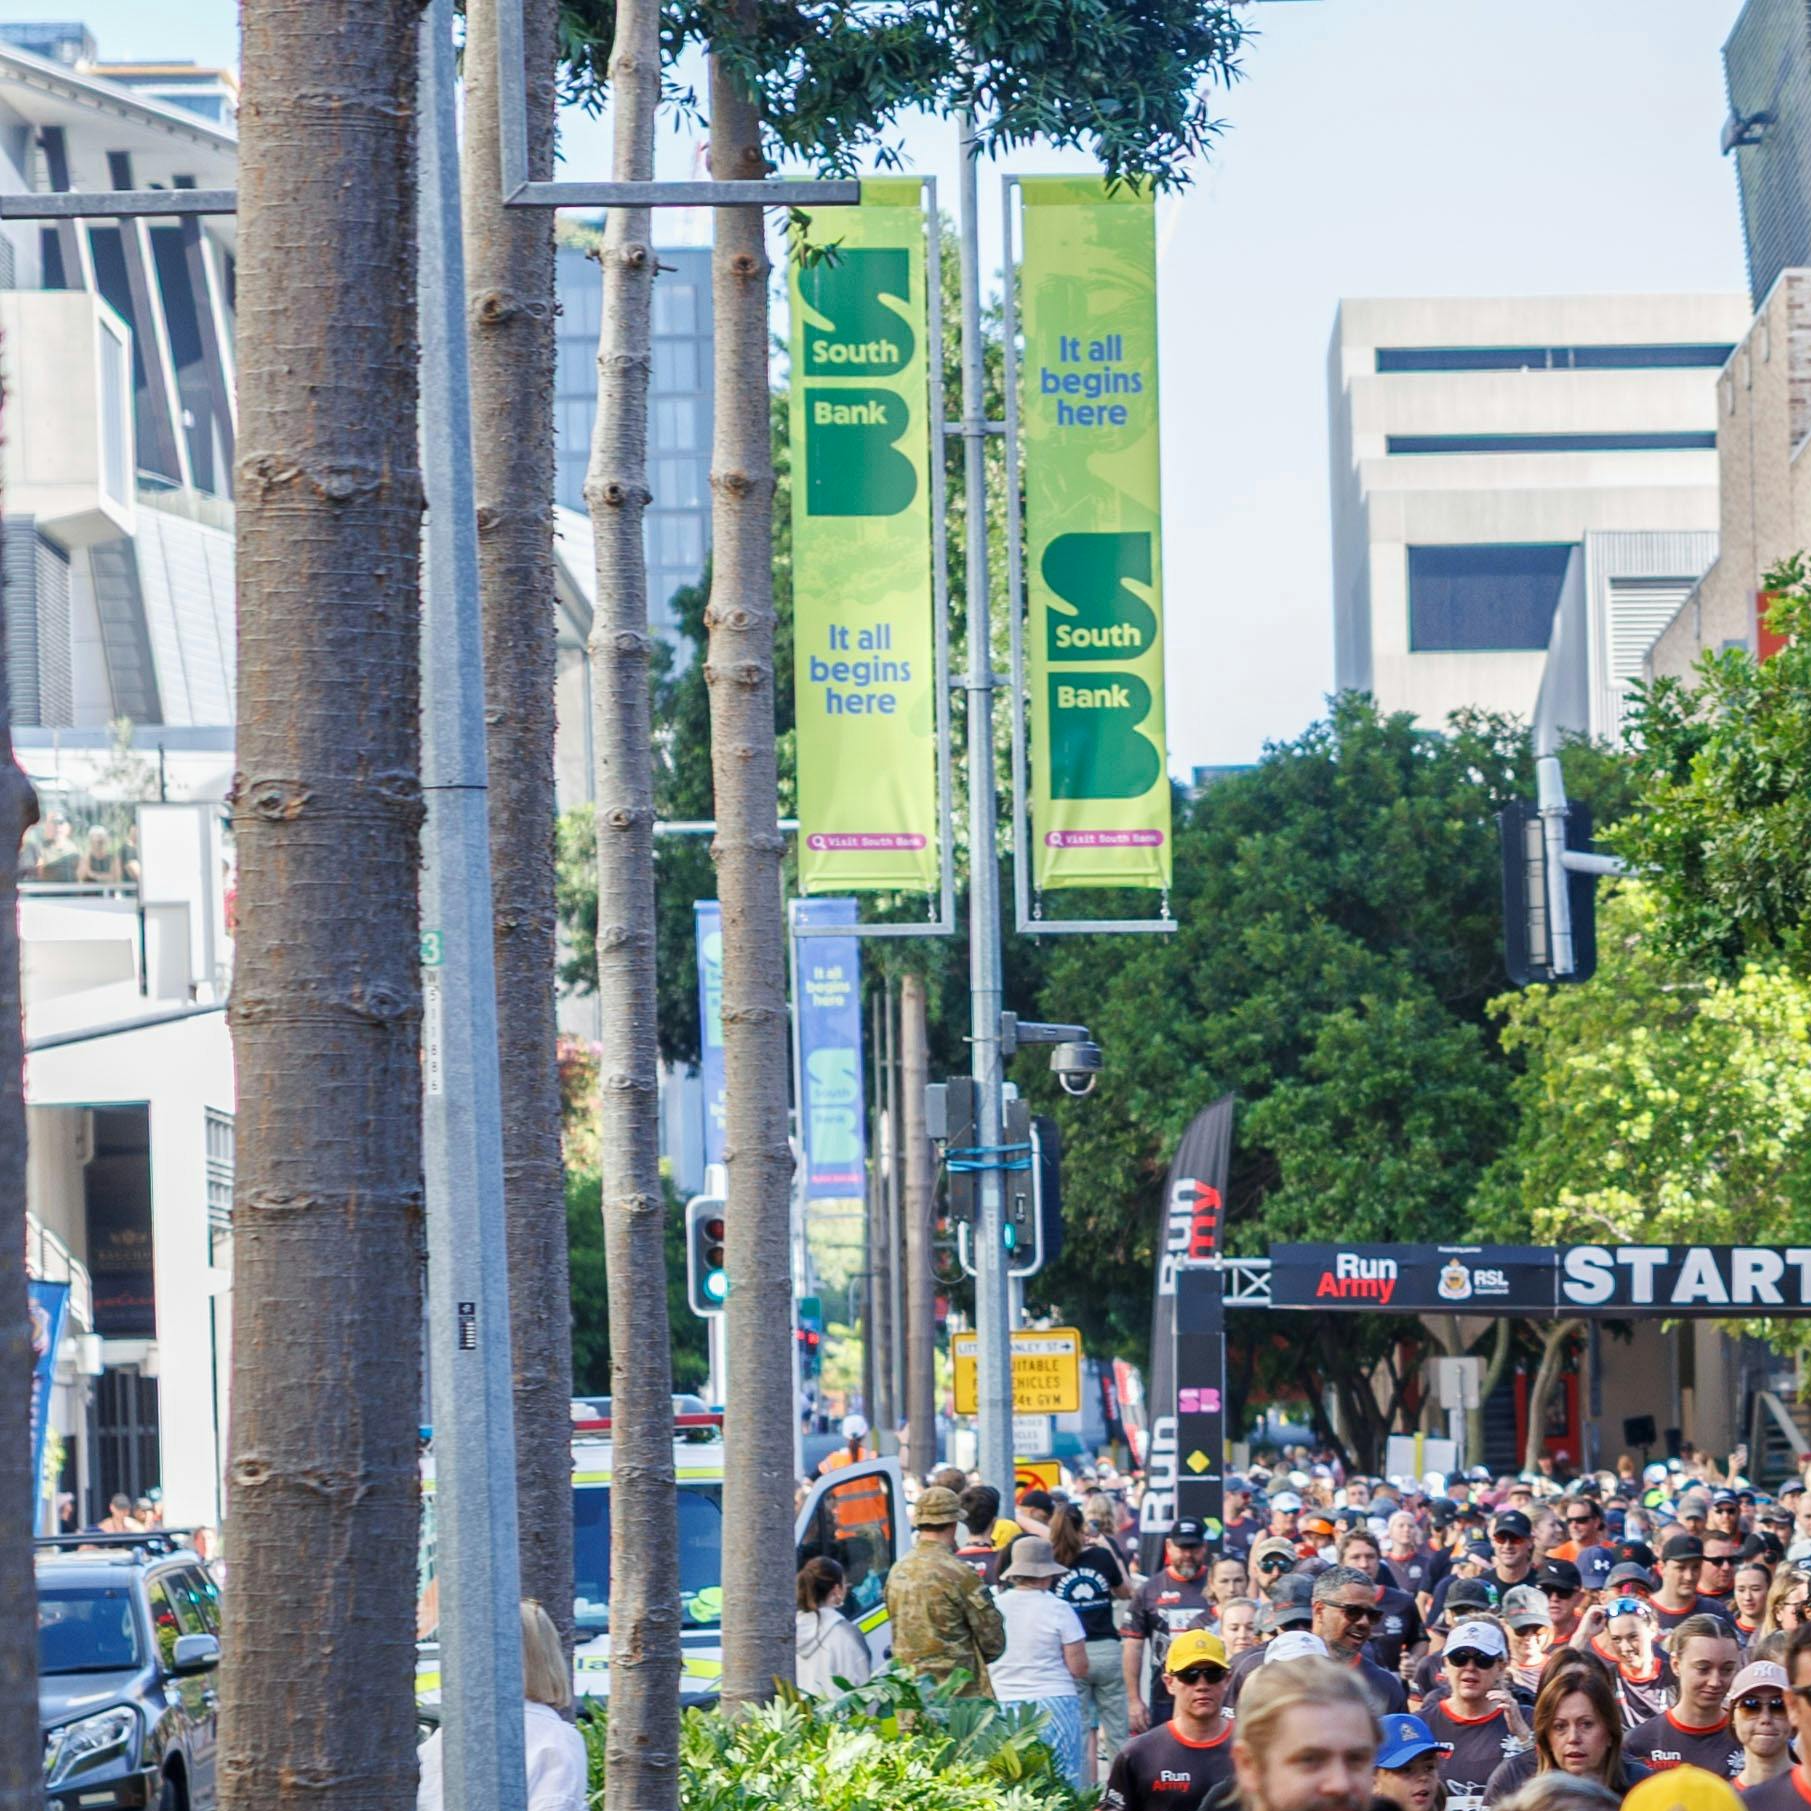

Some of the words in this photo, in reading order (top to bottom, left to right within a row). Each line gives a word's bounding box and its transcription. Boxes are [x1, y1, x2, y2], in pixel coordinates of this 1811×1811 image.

[812, 339, 899, 364] South
[1060, 336, 1082, 363] It
[1088, 335, 1123, 363] all
[1040, 366, 1143, 399] begins
[814, 401, 888, 425] Bank
[1056, 399, 1128, 427] here
[829, 625, 852, 651] It
[858, 623, 891, 651] all
[1055, 623, 1142, 649] South
[809, 655, 912, 687] begins
[826, 687, 897, 715] here
[1057, 685, 1130, 709] Bank
[861, 836, 893, 847] South
[1099, 833, 1129, 844] South
[1189, 1180, 1223, 1258] my
[1337, 1253, 1397, 1280] Run
[1474, 1270, 1509, 1286] RSL
[1316, 1272, 1397, 1304] Army
[1011, 1359, 1060, 1372] UITABLE
[1012, 1377, 1061, 1389] EHICLES
[1139, 1417, 1178, 1533] Run
[1652, 1750, 1681, 1761] Run
[1152, 1781, 1191, 1792] Army
[1161, 1770, 1191, 1782] Run
